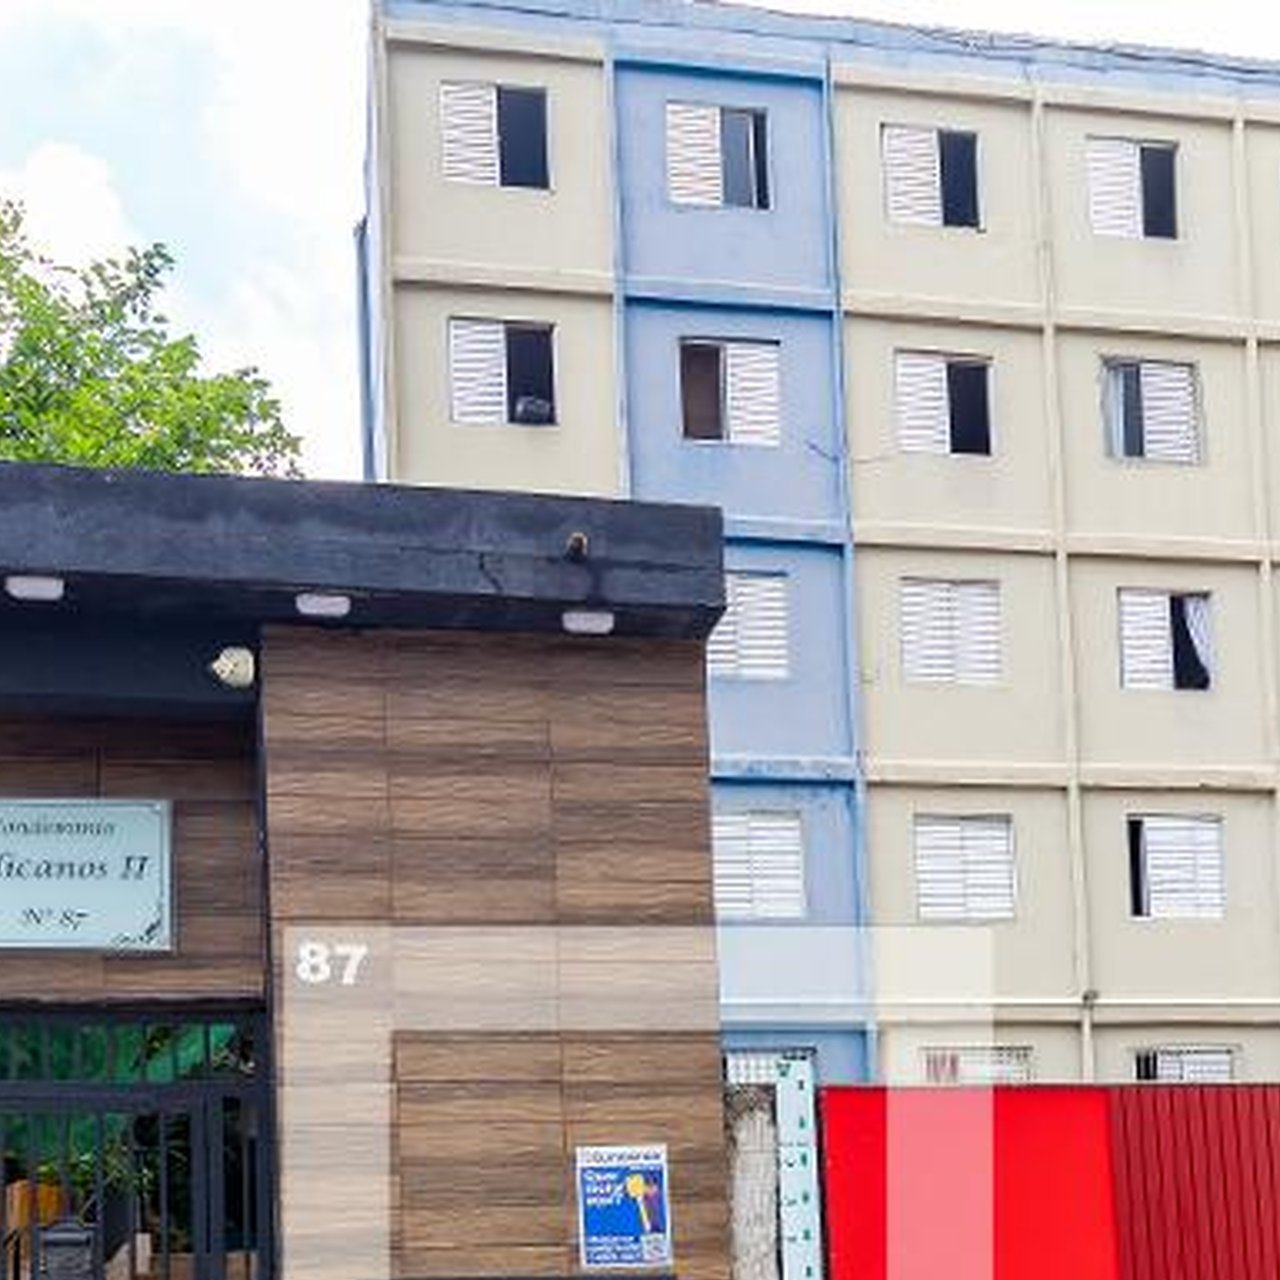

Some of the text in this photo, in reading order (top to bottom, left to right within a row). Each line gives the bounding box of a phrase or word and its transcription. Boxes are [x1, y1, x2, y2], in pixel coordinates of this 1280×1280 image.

[120, 855, 149, 881] II
[59, 909, 90, 931] 87
[296, 941, 368, 985] 87
